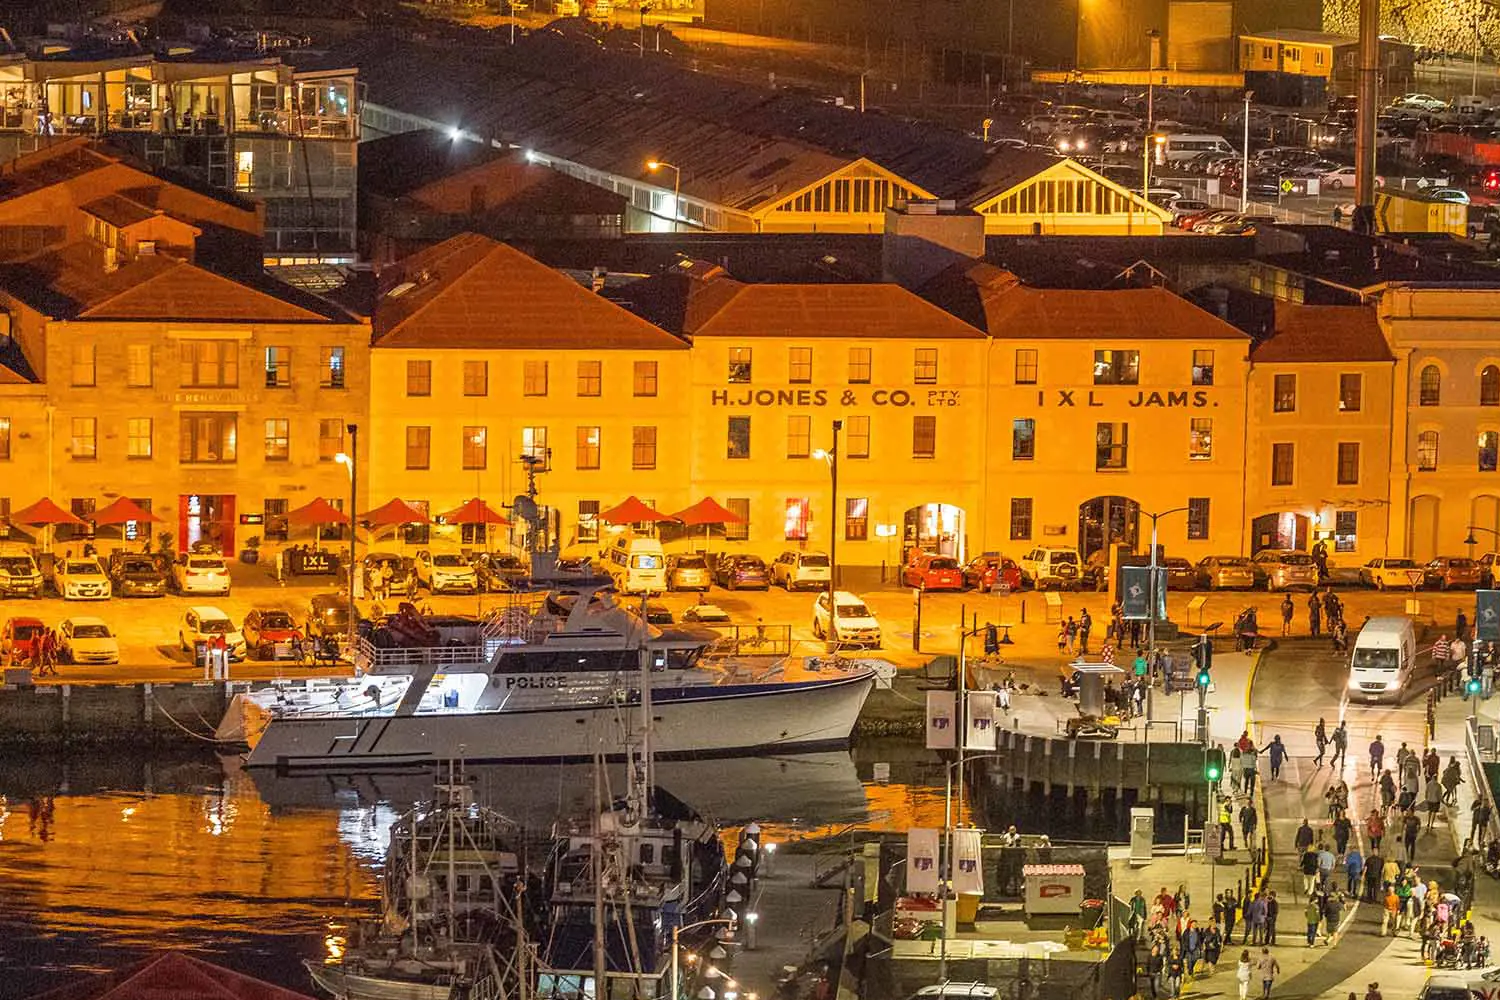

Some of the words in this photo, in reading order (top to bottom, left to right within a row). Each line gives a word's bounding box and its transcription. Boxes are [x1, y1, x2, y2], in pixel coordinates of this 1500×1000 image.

[841, 389, 858, 407] &
[871, 389, 916, 407] CO.
[1127, 390, 1219, 408] JAMS.
[303, 556, 329, 565] IXL
[506, 677, 568, 690] POLICE
